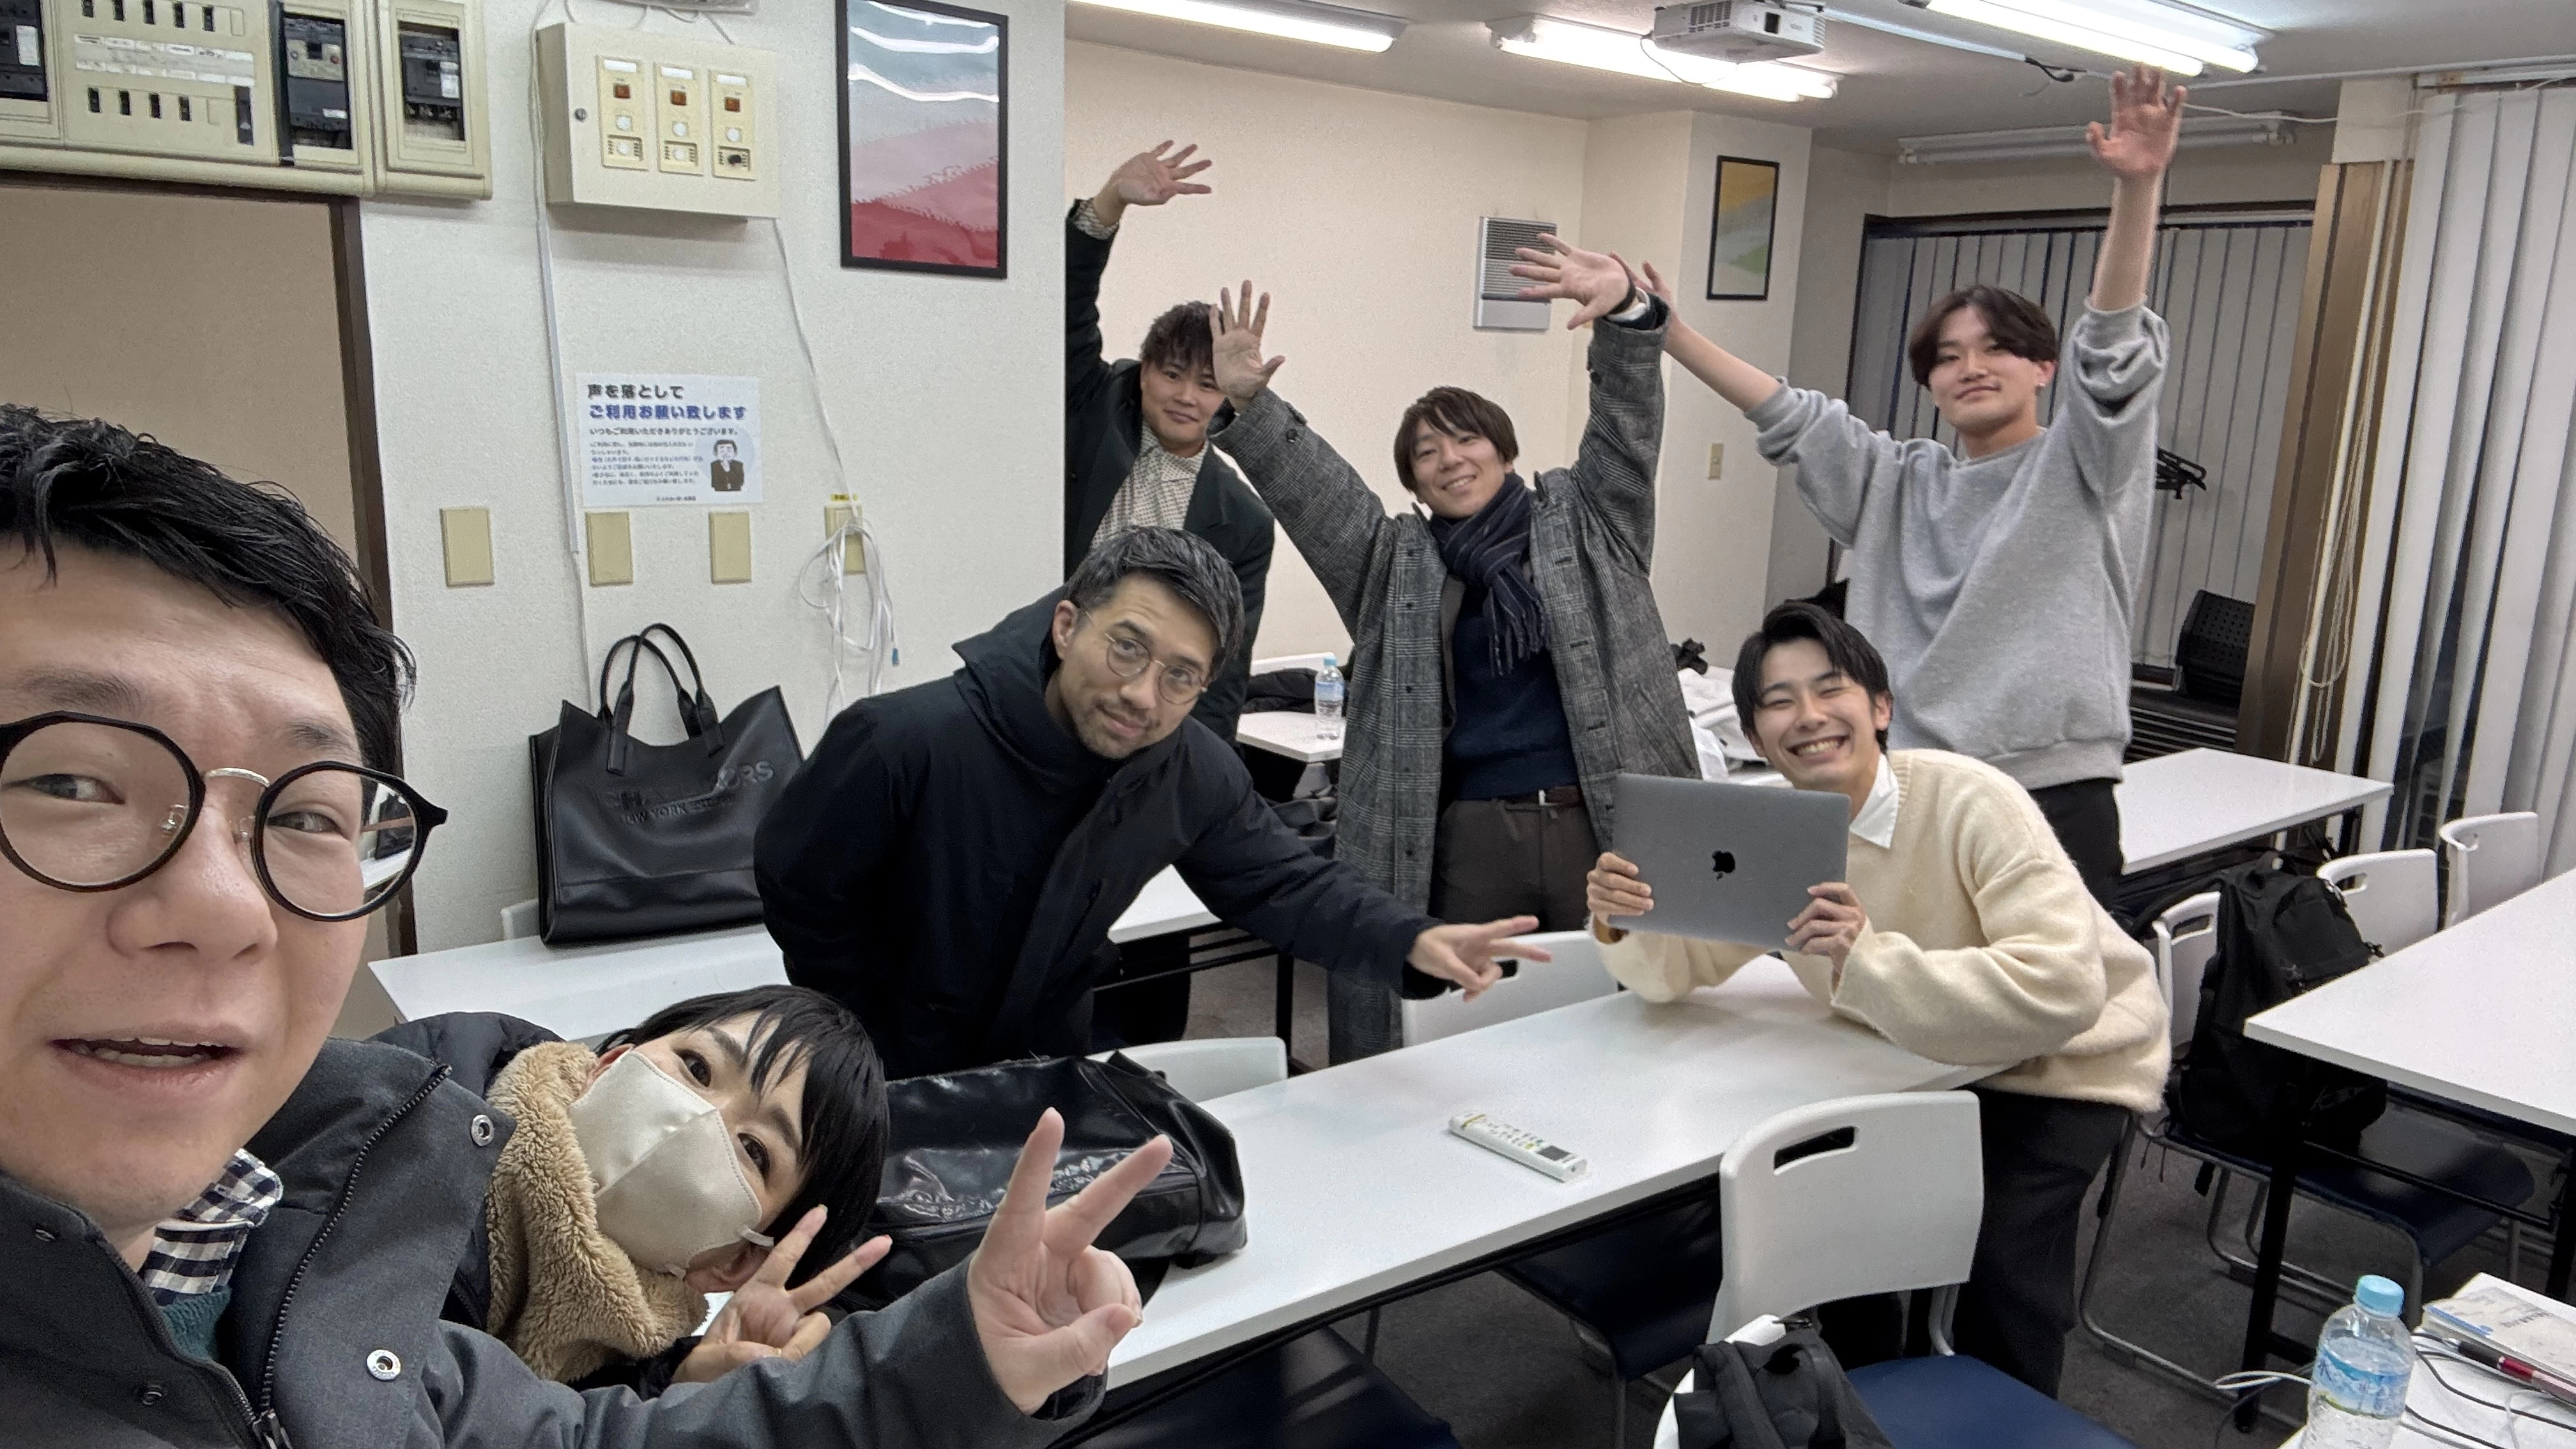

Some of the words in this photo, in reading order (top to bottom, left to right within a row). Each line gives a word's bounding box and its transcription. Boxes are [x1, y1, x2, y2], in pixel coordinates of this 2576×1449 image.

[587, 384, 684, 399] 声を落として
[589, 404, 746, 420] ご利用お願い致します
